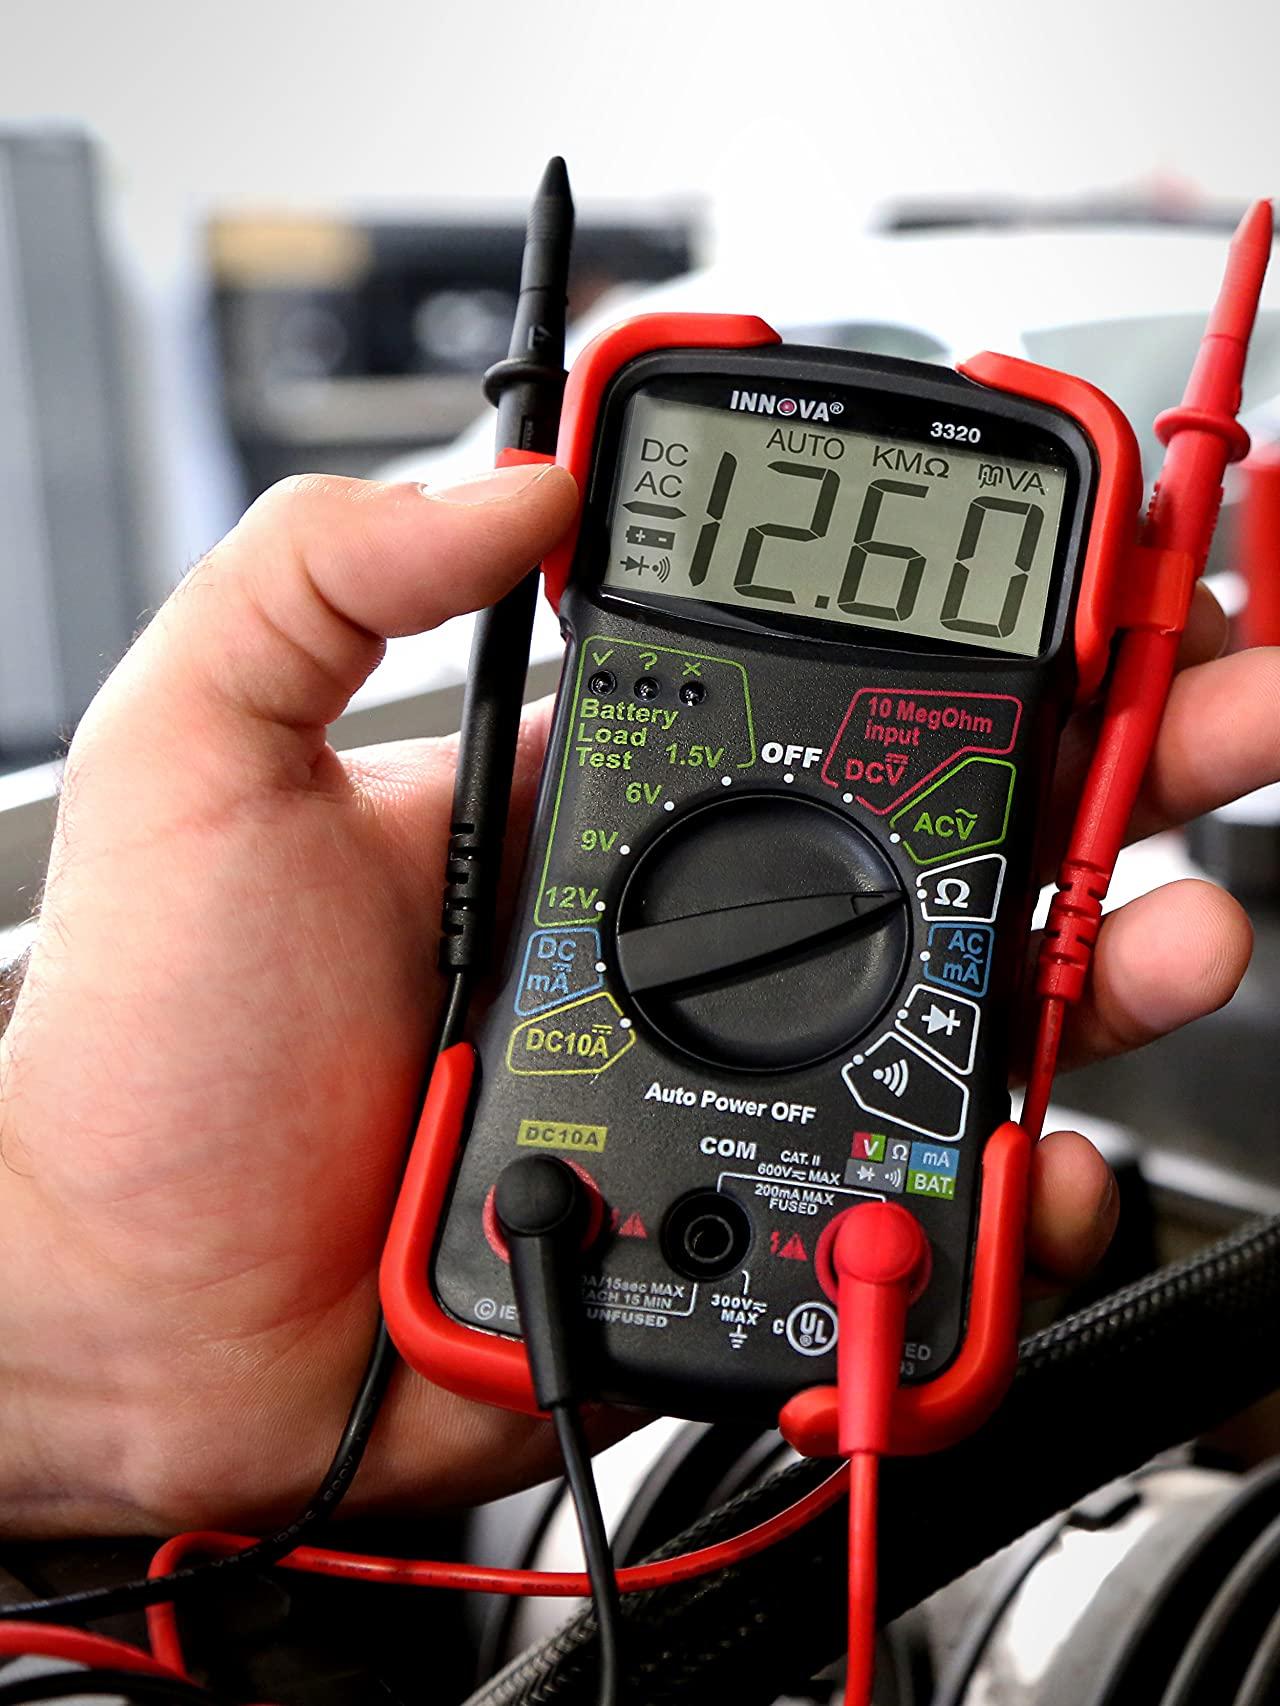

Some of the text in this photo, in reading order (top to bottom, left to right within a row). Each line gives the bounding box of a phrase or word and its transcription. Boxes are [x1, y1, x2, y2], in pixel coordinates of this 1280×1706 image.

[766, 428, 845, 460] AUTO
[930, 421, 981, 444] 3320
[641, 438, 689, 466] DC
[635, 471, 683, 498] AC
[688, 451, 1044, 638] 12.60
[580, 698, 679, 730] Battery
[868, 696, 993, 734] 10 MegOhm
[577, 723, 647, 747] Load
[865, 721, 920, 747] input
[575, 746, 632, 769] Test
[665, 743, 724, 768] 1.5V
[761, 742, 823, 769] OFF
[625, 782, 662, 805] 6V
[581, 829, 619, 852] 9V
[545, 886, 599, 910] 12V
[537, 936, 576, 961] DC
[948, 930, 984, 955] AC
[526, 973, 569, 994] mA
[943, 961, 980, 985] mA
[526, 1028, 609, 1059] DC10A
[644, 1082, 817, 1126] Auto Power OFF
[525, 1127, 601, 1146] DC10A
[863, 1139, 879, 1156] V
[700, 1137, 757, 1160] COM
[780, 1150, 809, 1166] CAT.
[922, 1151, 950, 1168] mA
[808, 1170, 841, 1186] MAX
[914, 1173, 953, 1195] BAT.
[754, 1184, 835, 1206] 200mA MAX
[769, 1198, 818, 1215] FUSED
[624, 1294, 640, 1306] 15
[643, 1295, 672, 1309] MIN
[650, 1282, 685, 1298] MAX
[499, 1305, 519, 1320] IE
[586, 1307, 668, 1328] UNFUSED
[721, 1309, 759, 1326] MAX
